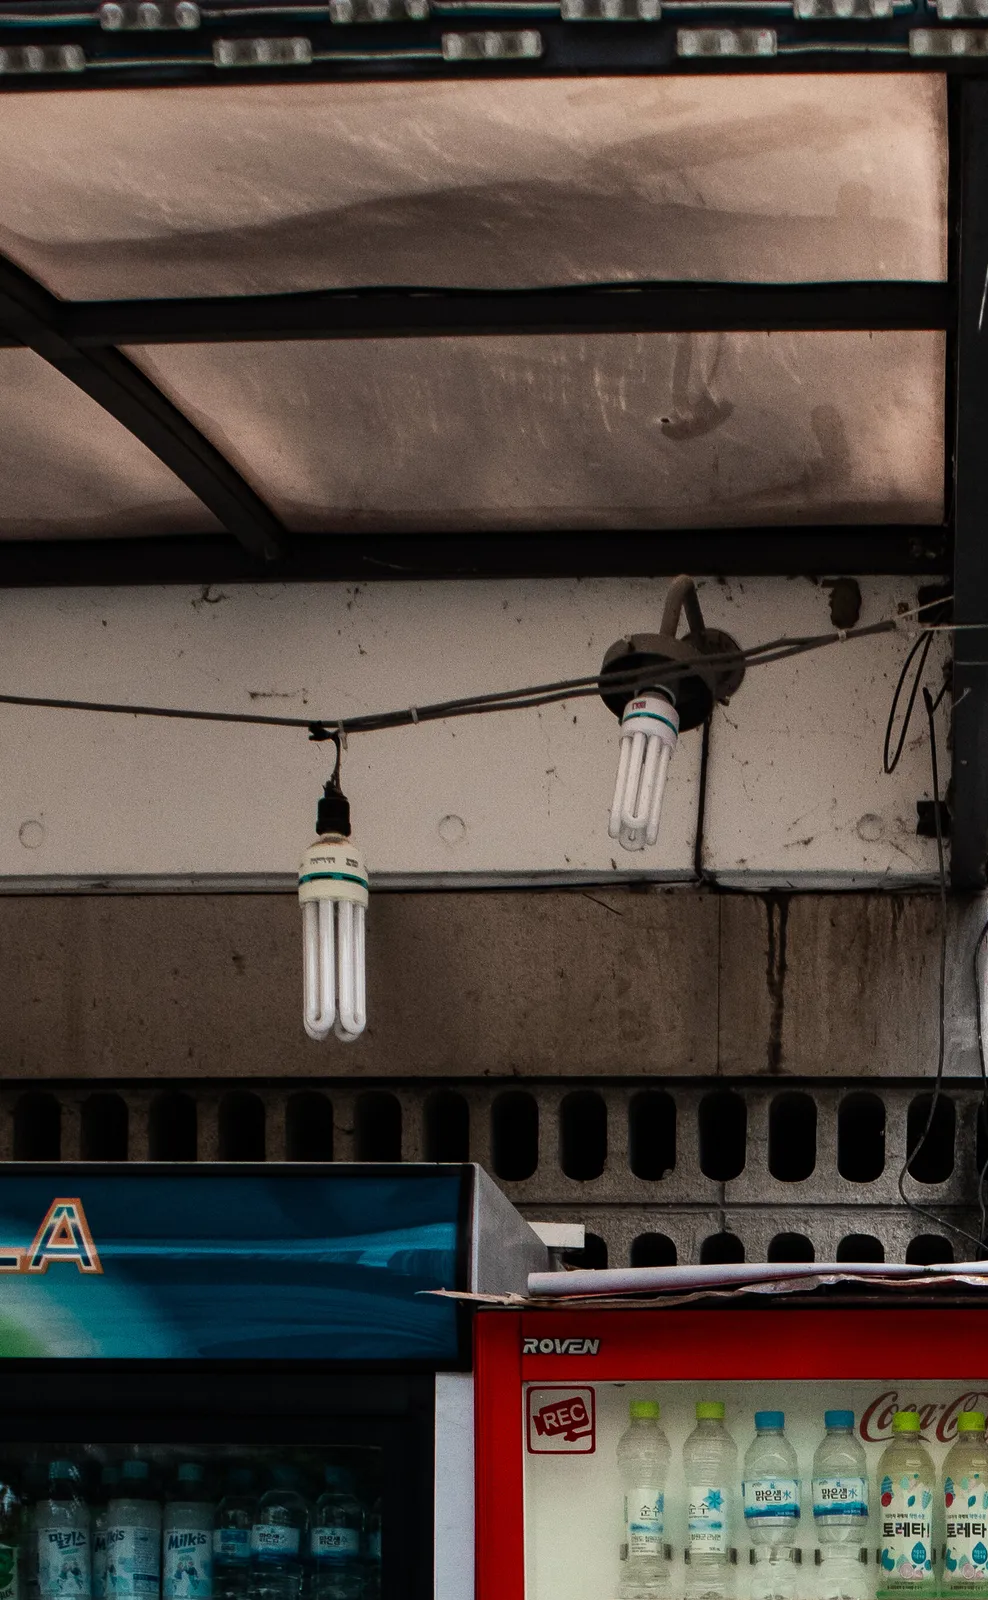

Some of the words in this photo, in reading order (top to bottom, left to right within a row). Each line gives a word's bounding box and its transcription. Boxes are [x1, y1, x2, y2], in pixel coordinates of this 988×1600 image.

[0, 1198, 103, 1274] A
[523, 1338, 600, 1355] ROVEN
[542, 1402, 587, 1431] REC
[639, 1504, 660, 1517] 순수
[882, 1522, 930, 1538] 토레타!
[168, 1533, 207, 1550] Milkis
